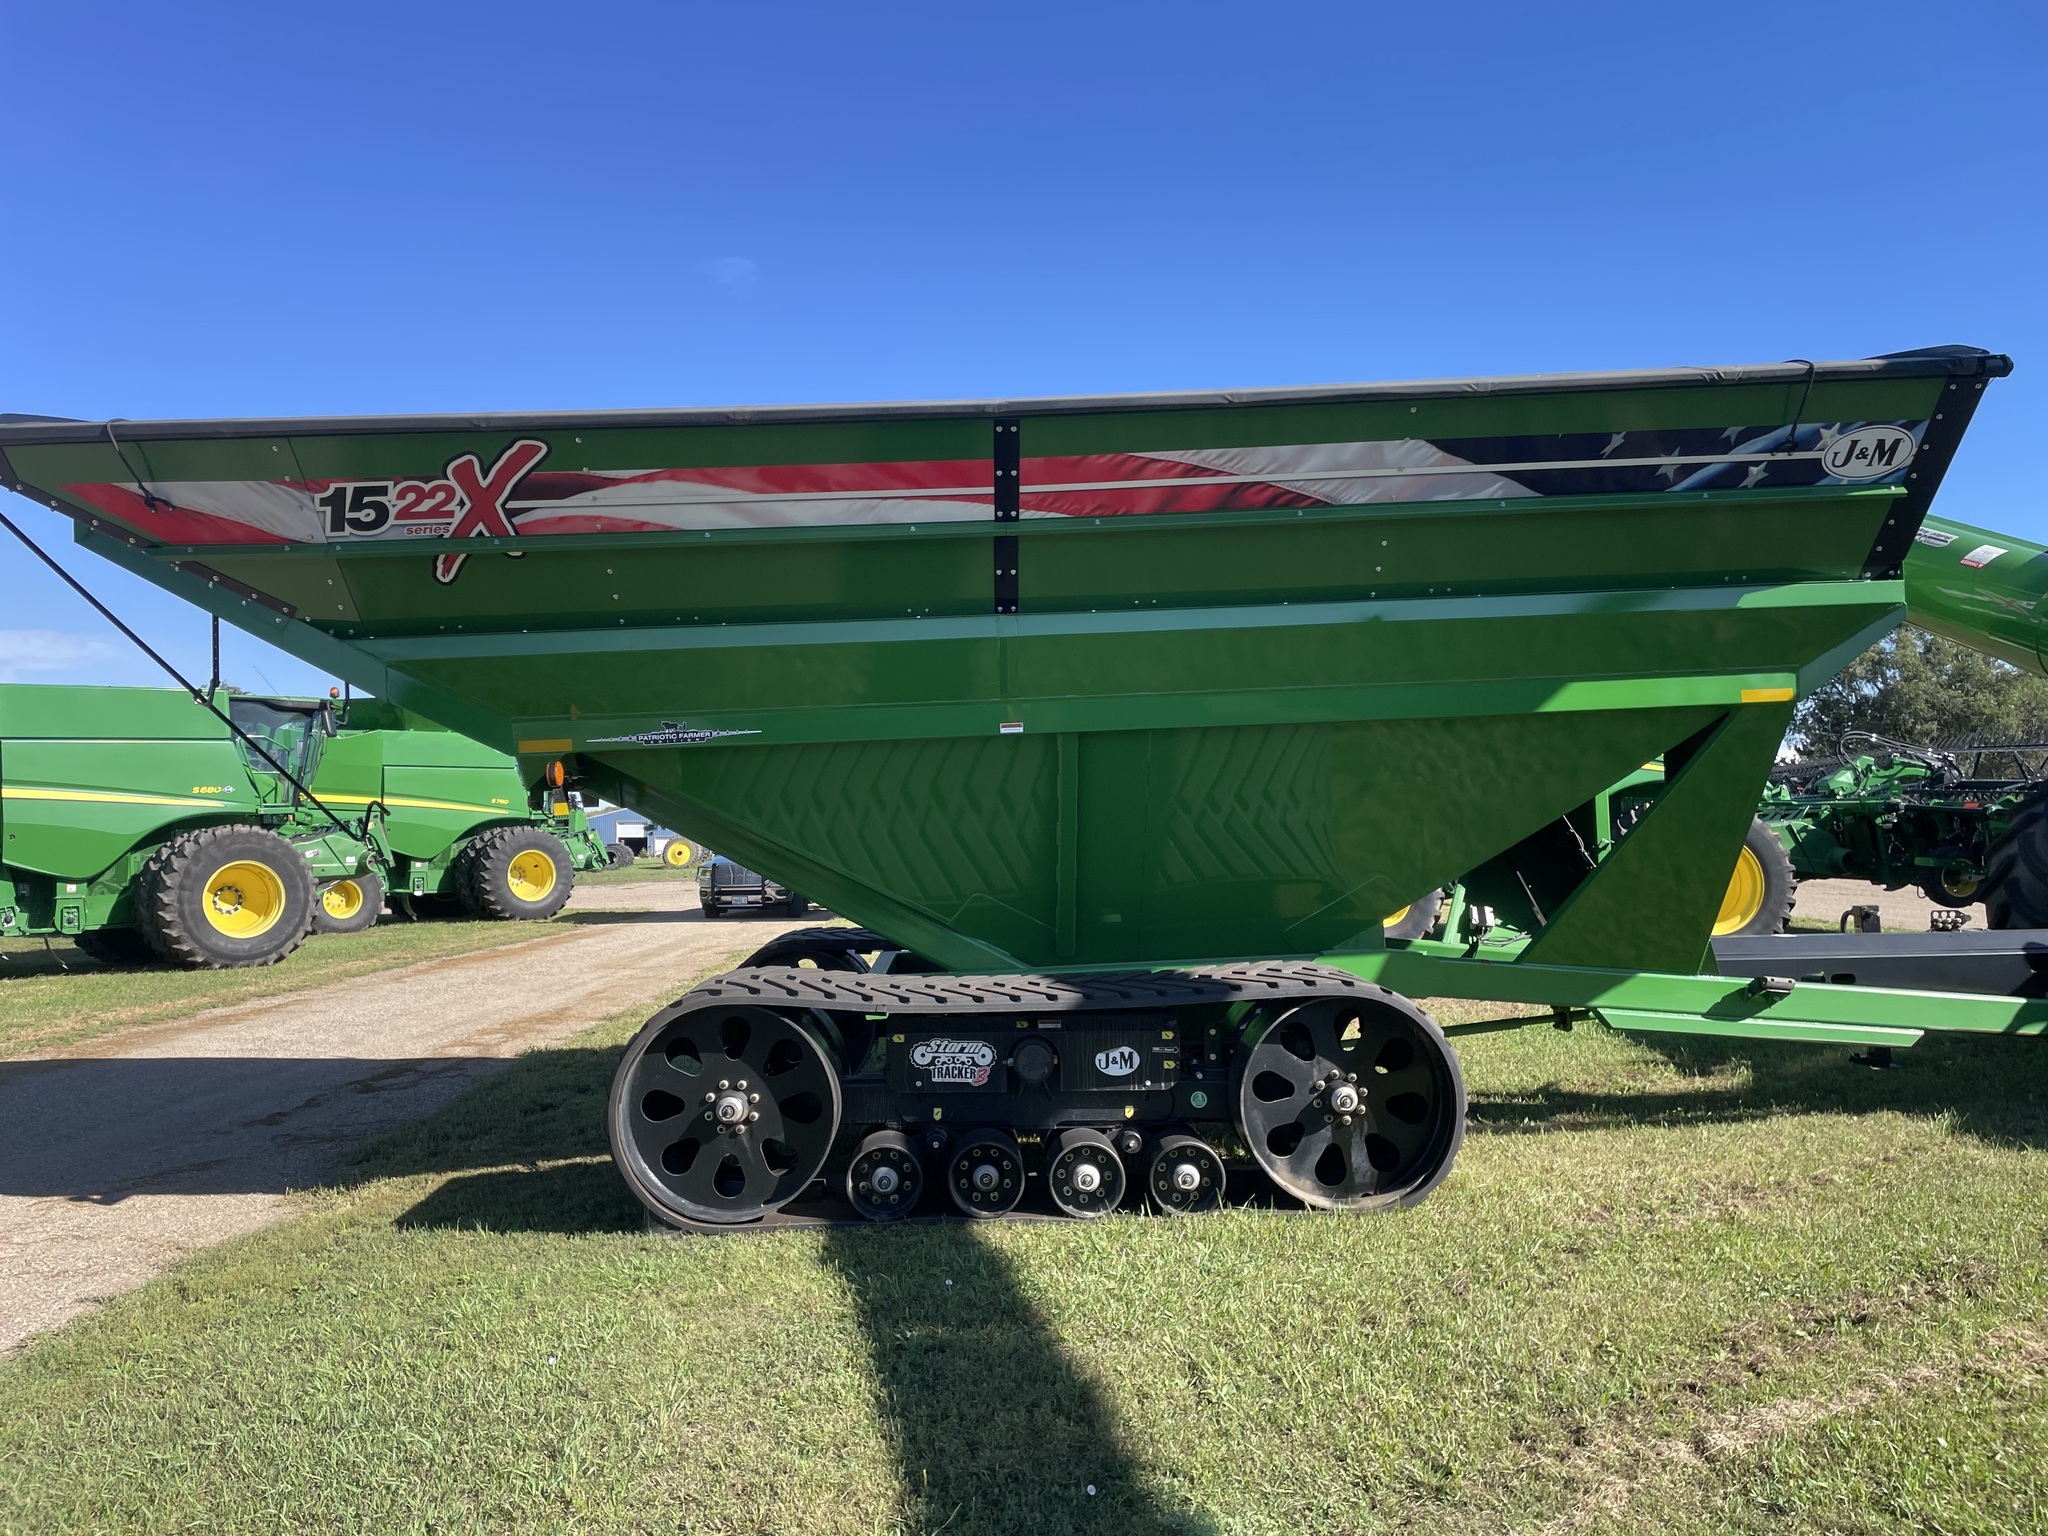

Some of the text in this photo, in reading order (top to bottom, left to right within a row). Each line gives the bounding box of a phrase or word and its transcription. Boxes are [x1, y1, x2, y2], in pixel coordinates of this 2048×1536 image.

[1831, 438, 1904, 468] J&M
[406, 524, 450, 535] series
[638, 732, 711, 741] PATRIOTIC FARMER
[926, 1040, 983, 1053] Storm
[1098, 1051, 1134, 1070] J&M
[931, 1065, 977, 1080] TRACKER
